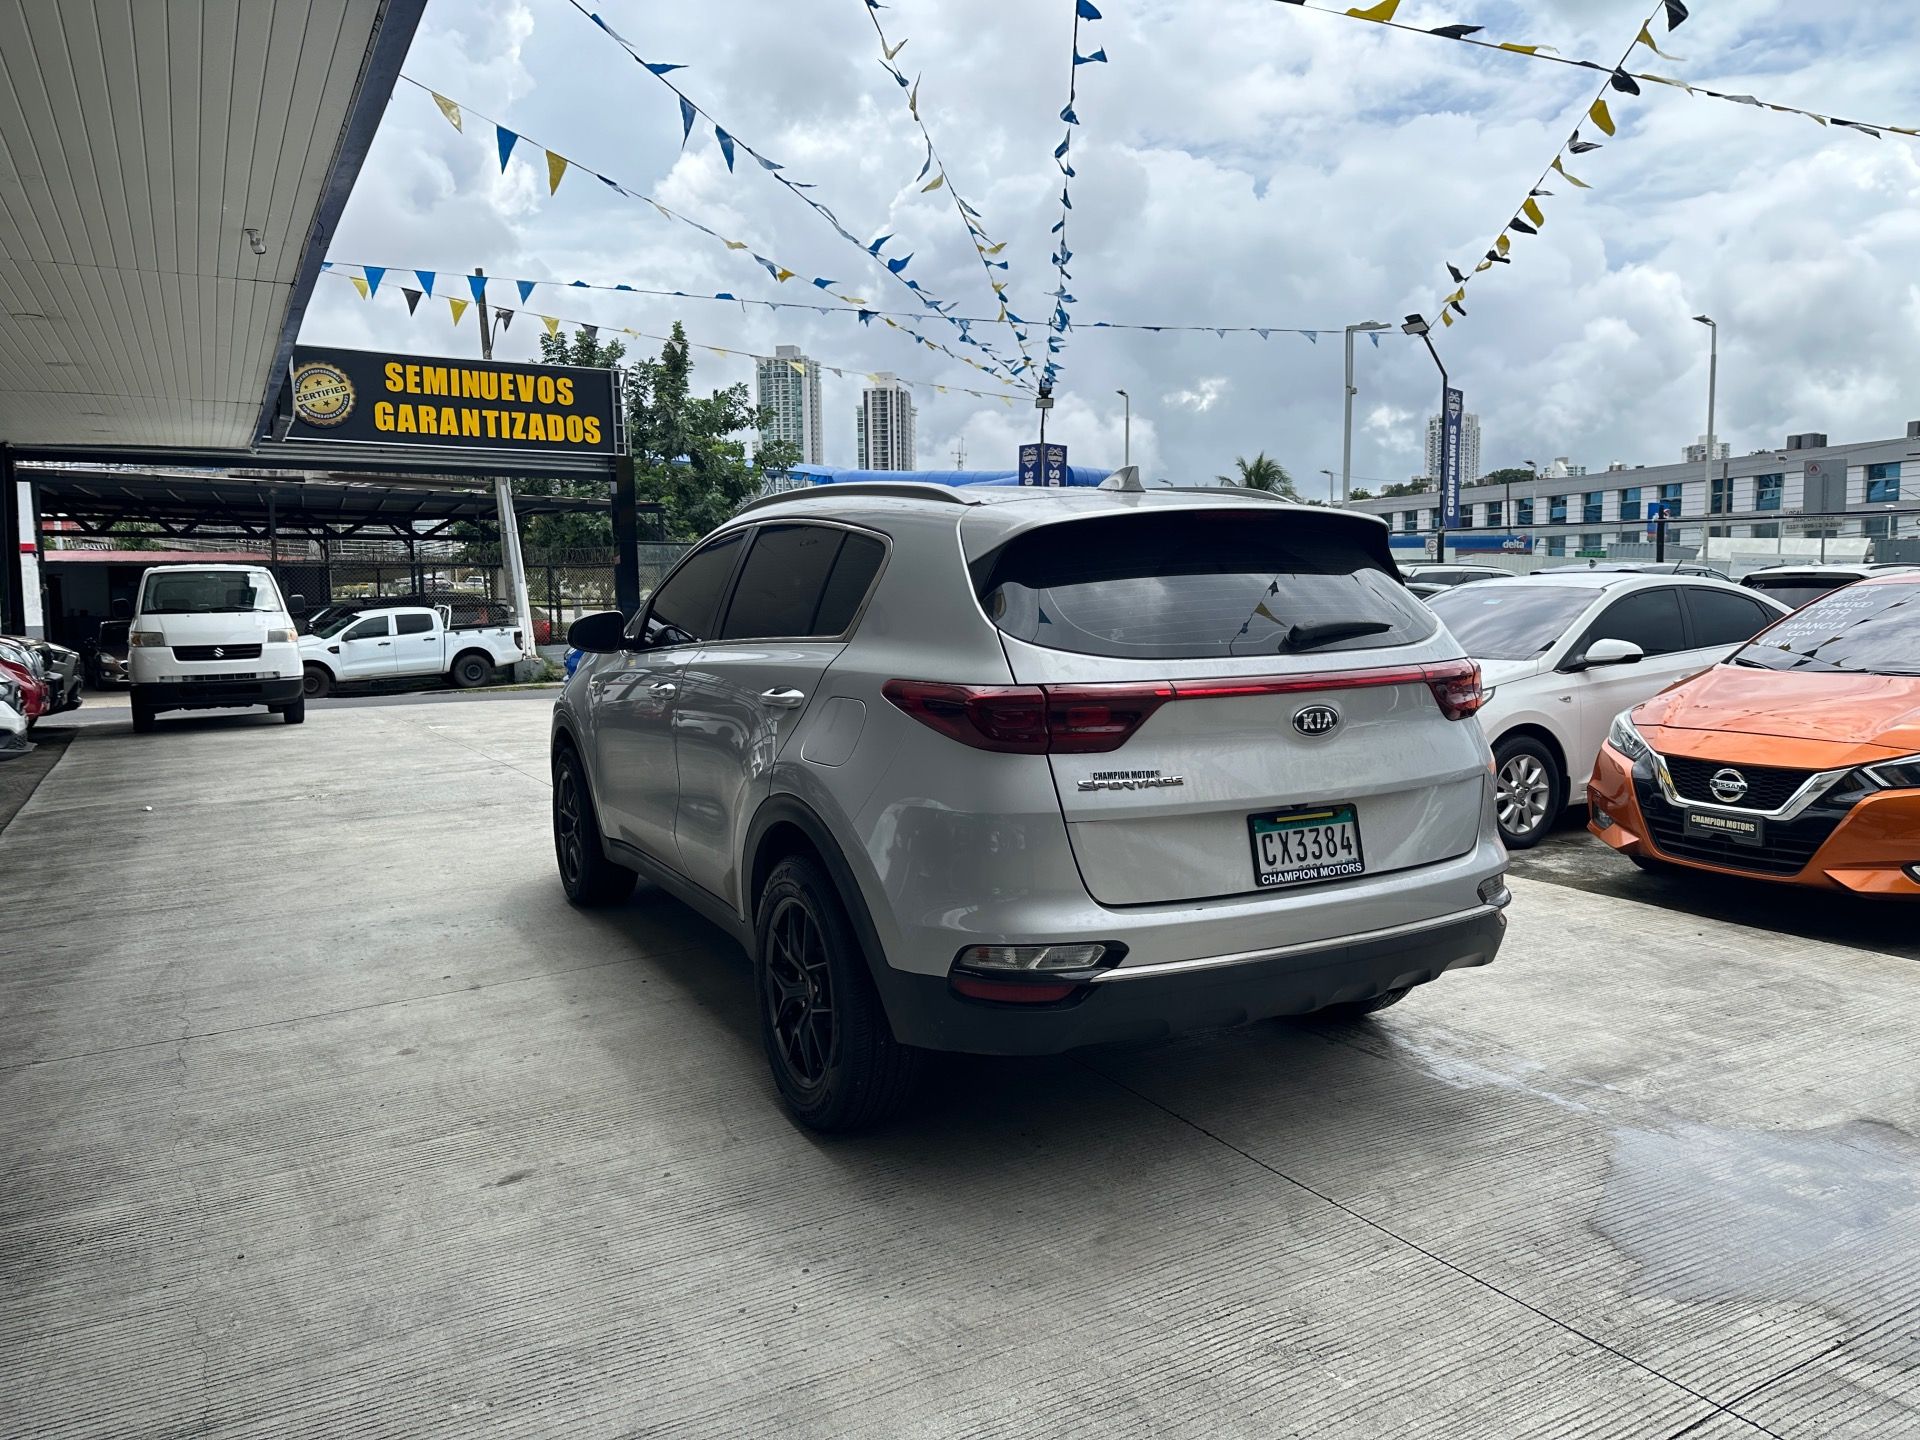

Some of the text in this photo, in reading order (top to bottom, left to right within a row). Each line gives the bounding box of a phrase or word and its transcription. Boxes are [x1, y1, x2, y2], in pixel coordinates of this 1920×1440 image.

[384, 362, 574, 406] SEMINUEVOS
[295, 385, 348, 403] CERTIFIED
[374, 401, 601, 444] GARANTIZADOS
[1446, 424, 1457, 517] COMPRAMOS
[1502, 539, 1525, 549] delta
[1303, 711, 1333, 729] KIA
[1077, 776, 1184, 792] SPORTAGE
[1092, 770, 1160, 780] CHAMPION MOTORS
[1691, 814, 1726, 828] CHAMPION
[1726, 820, 1755, 832] MOTORS
[1261, 824, 1353, 867] CX3384
[1261, 862, 1362, 885] CHAMPION MOTORS
